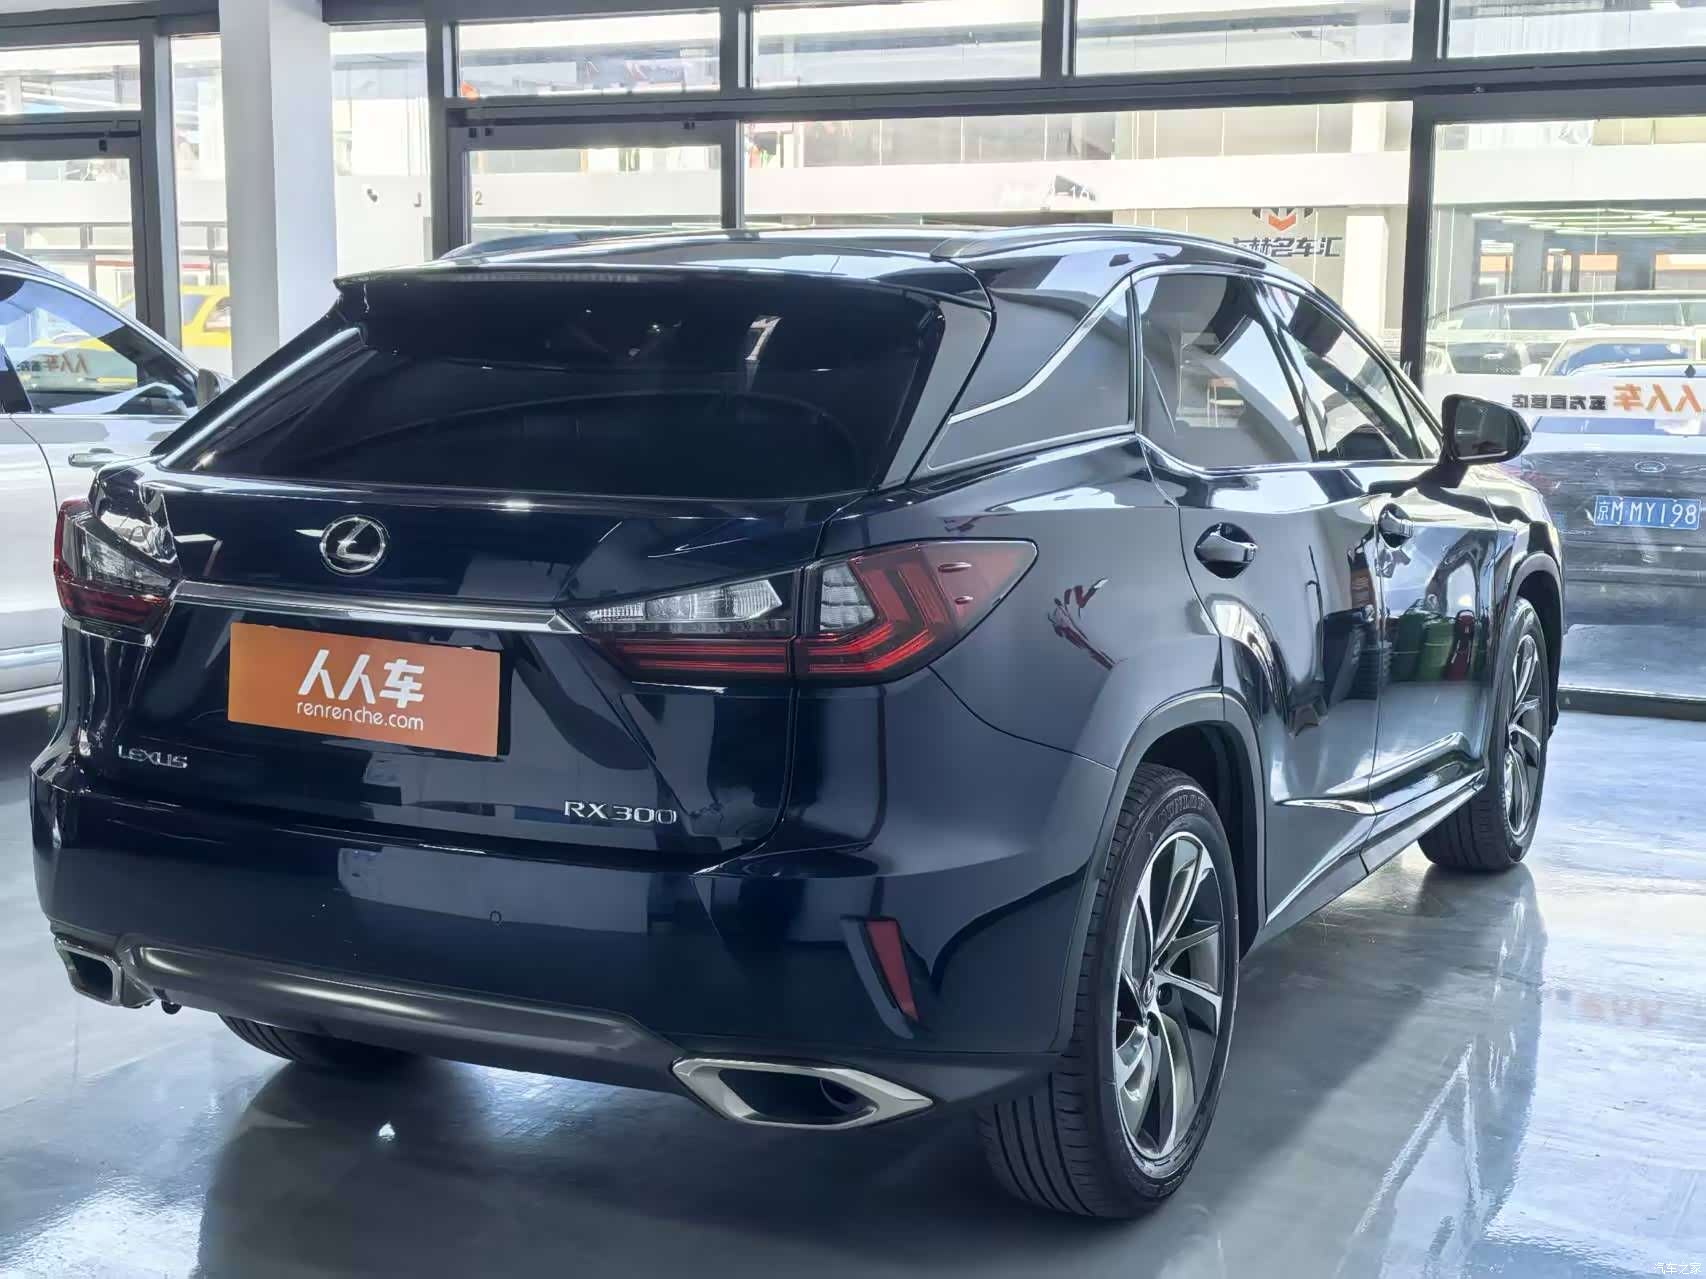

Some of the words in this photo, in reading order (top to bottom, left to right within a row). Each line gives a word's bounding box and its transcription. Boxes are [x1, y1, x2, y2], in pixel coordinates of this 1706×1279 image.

[297, 648, 425, 709] 人人车
[296, 701, 424, 731] renrenche.com
[118, 744, 188, 769] LEXUS
[564, 800, 609, 820] RX
[611, 805, 677, 824] 300
